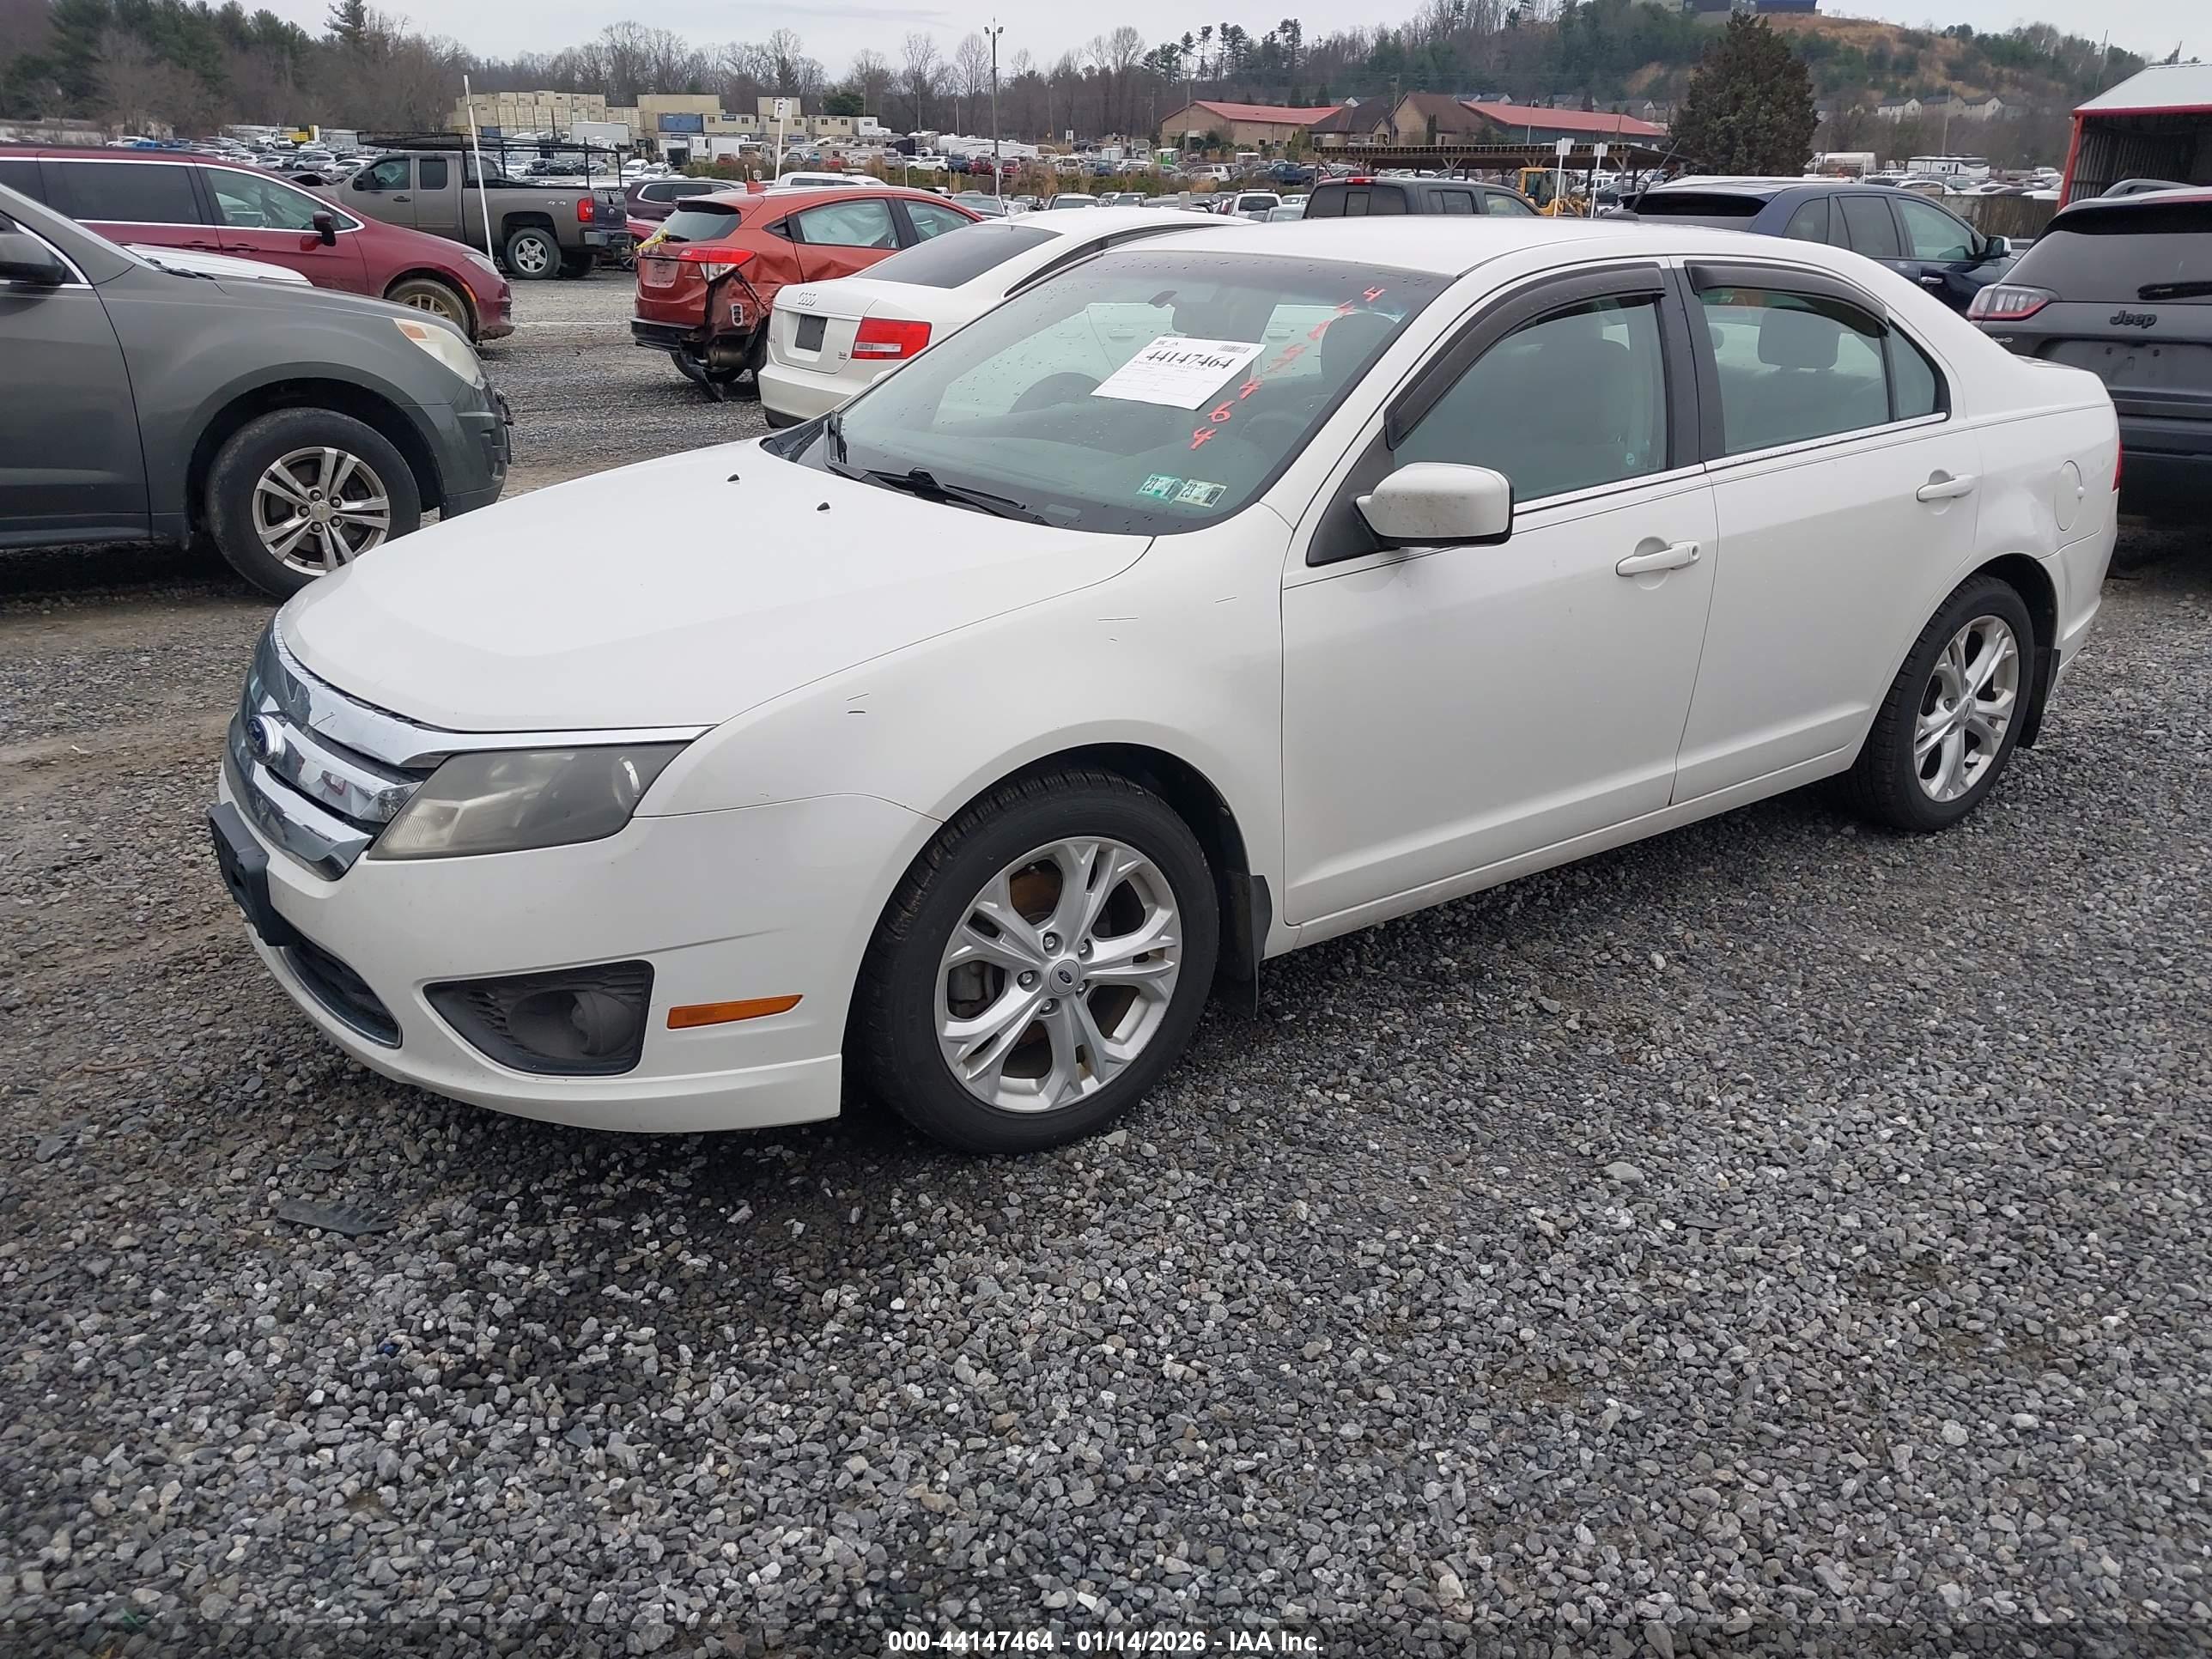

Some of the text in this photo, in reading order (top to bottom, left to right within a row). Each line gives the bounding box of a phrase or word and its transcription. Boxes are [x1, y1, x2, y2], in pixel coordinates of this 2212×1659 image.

[777, 101, 784, 115] F
[2110, 310, 2157, 329] Jeep
[1146, 350, 1236, 369] 44147464
